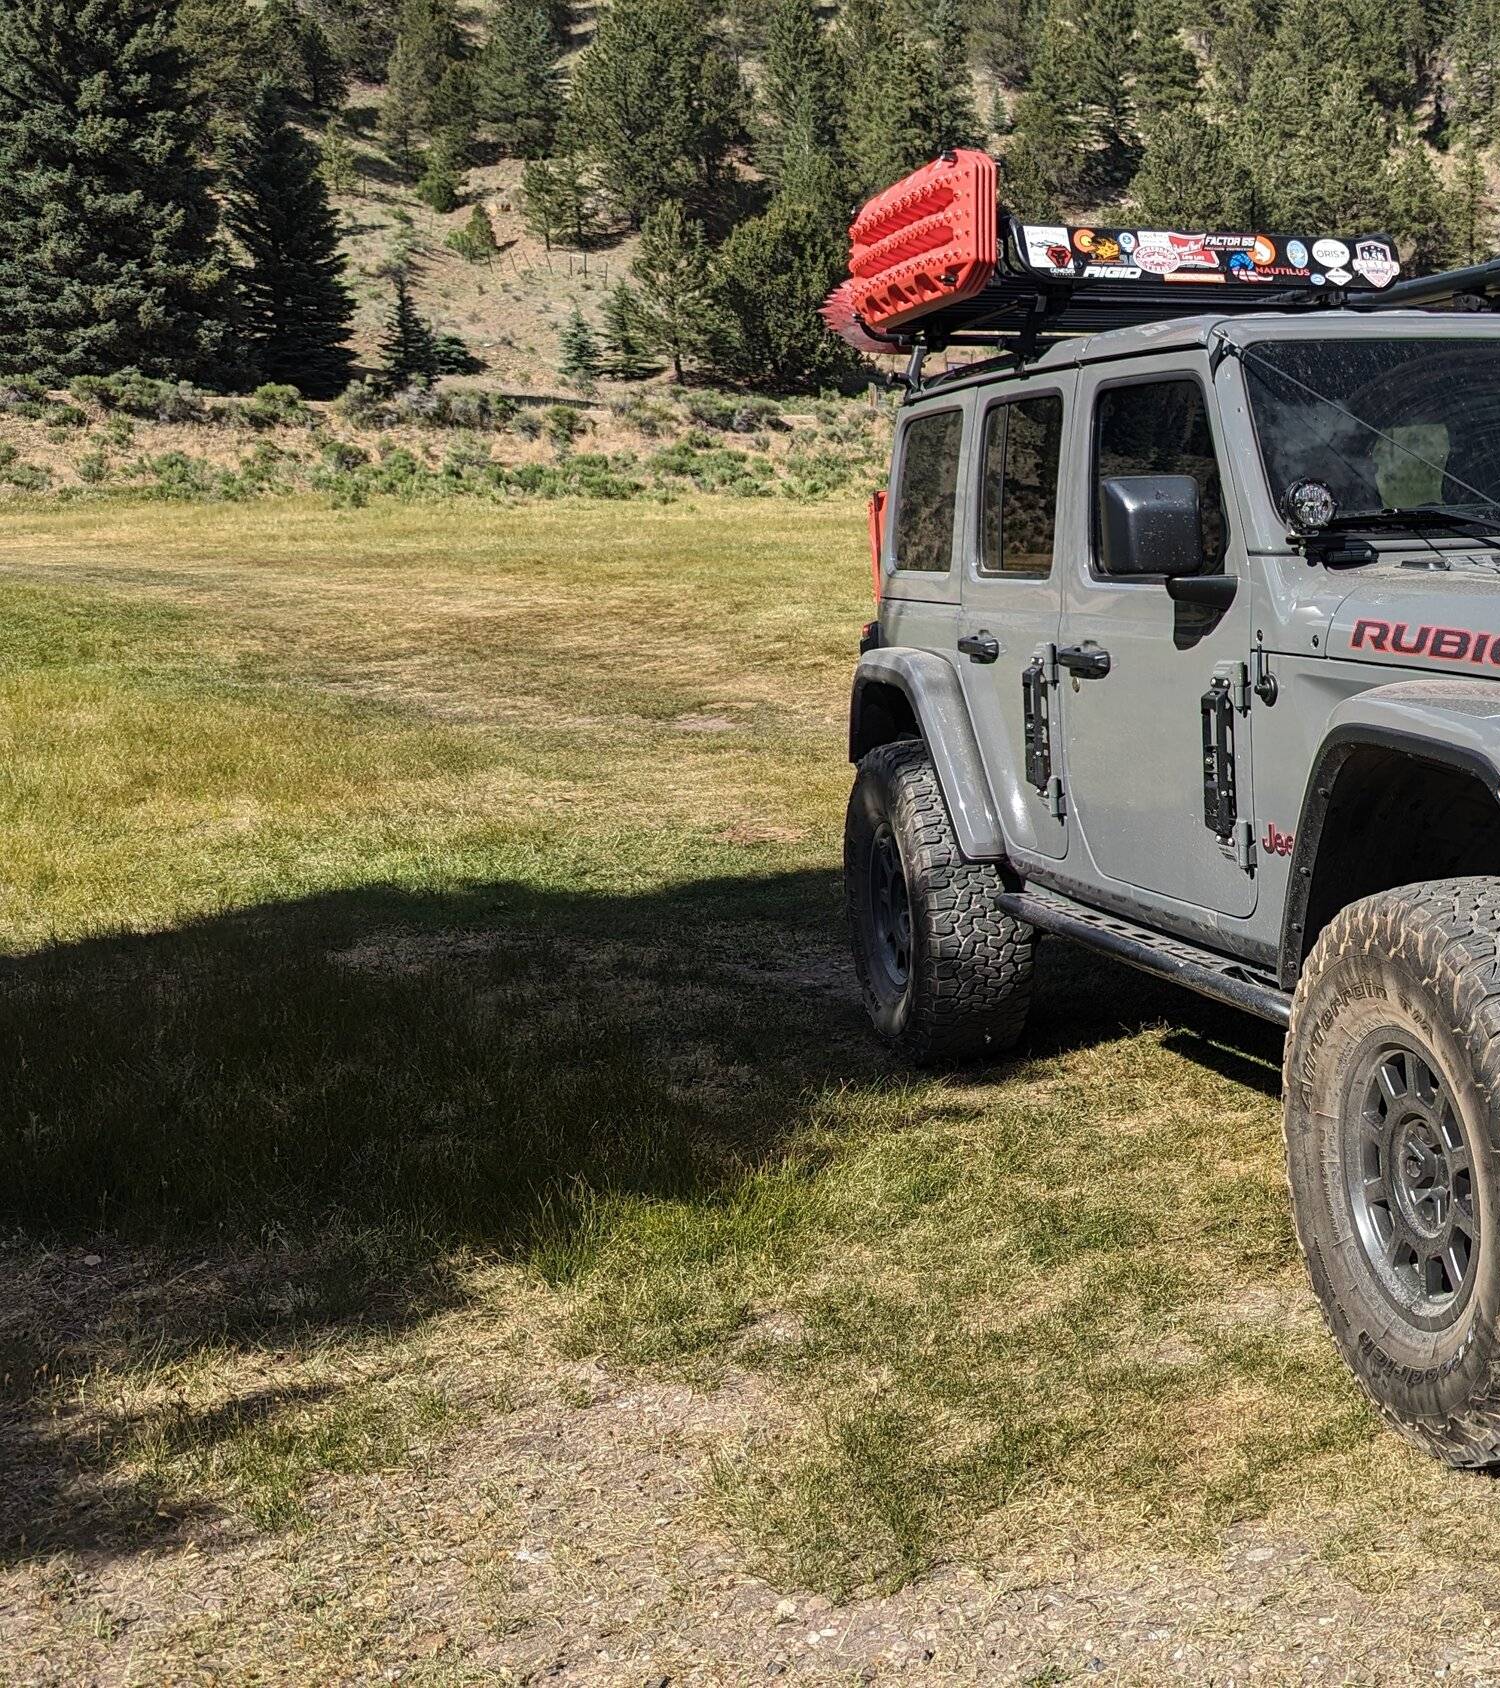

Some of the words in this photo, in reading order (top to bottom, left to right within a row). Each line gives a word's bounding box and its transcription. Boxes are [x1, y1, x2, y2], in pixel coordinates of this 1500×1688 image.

[1204, 236, 1241, 246] FACTOR
[1316, 250, 1340, 258] ORIS
[1083, 265, 1142, 279] RIGID
[1255, 266, 1311, 276] NAUTILUS
[1262, 822, 1295, 857] Jee
